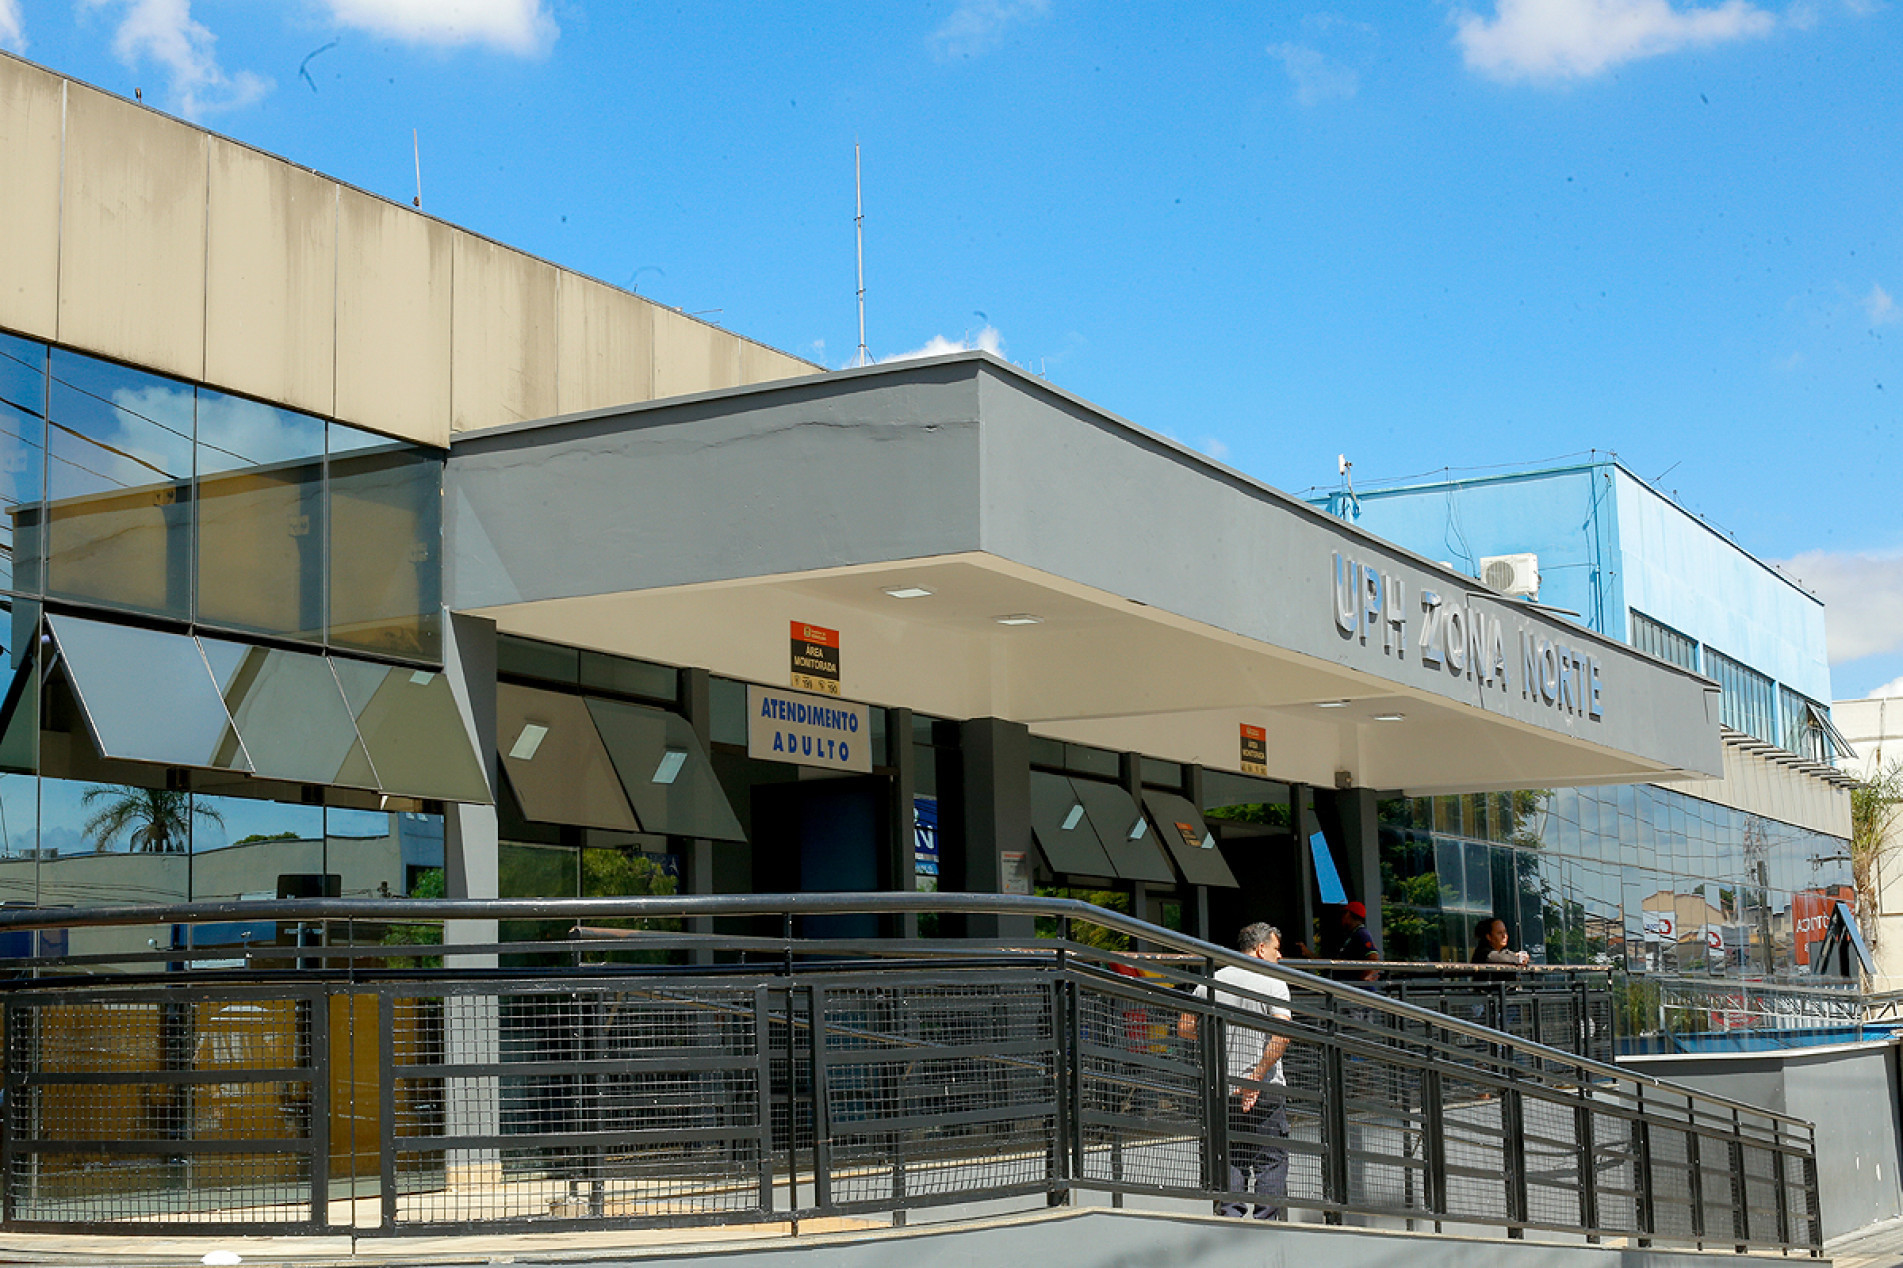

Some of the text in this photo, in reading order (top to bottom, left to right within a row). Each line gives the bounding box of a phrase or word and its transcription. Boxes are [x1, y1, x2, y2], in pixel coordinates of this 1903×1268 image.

[806, 643, 824, 658] ÁREA
[1331, 551, 1603, 722] UPH ZONA NORTE
[794, 655, 838, 673] MONITORADA
[761, 697, 858, 733] ATENDIMENTO
[773, 731, 849, 761] ADULTO
